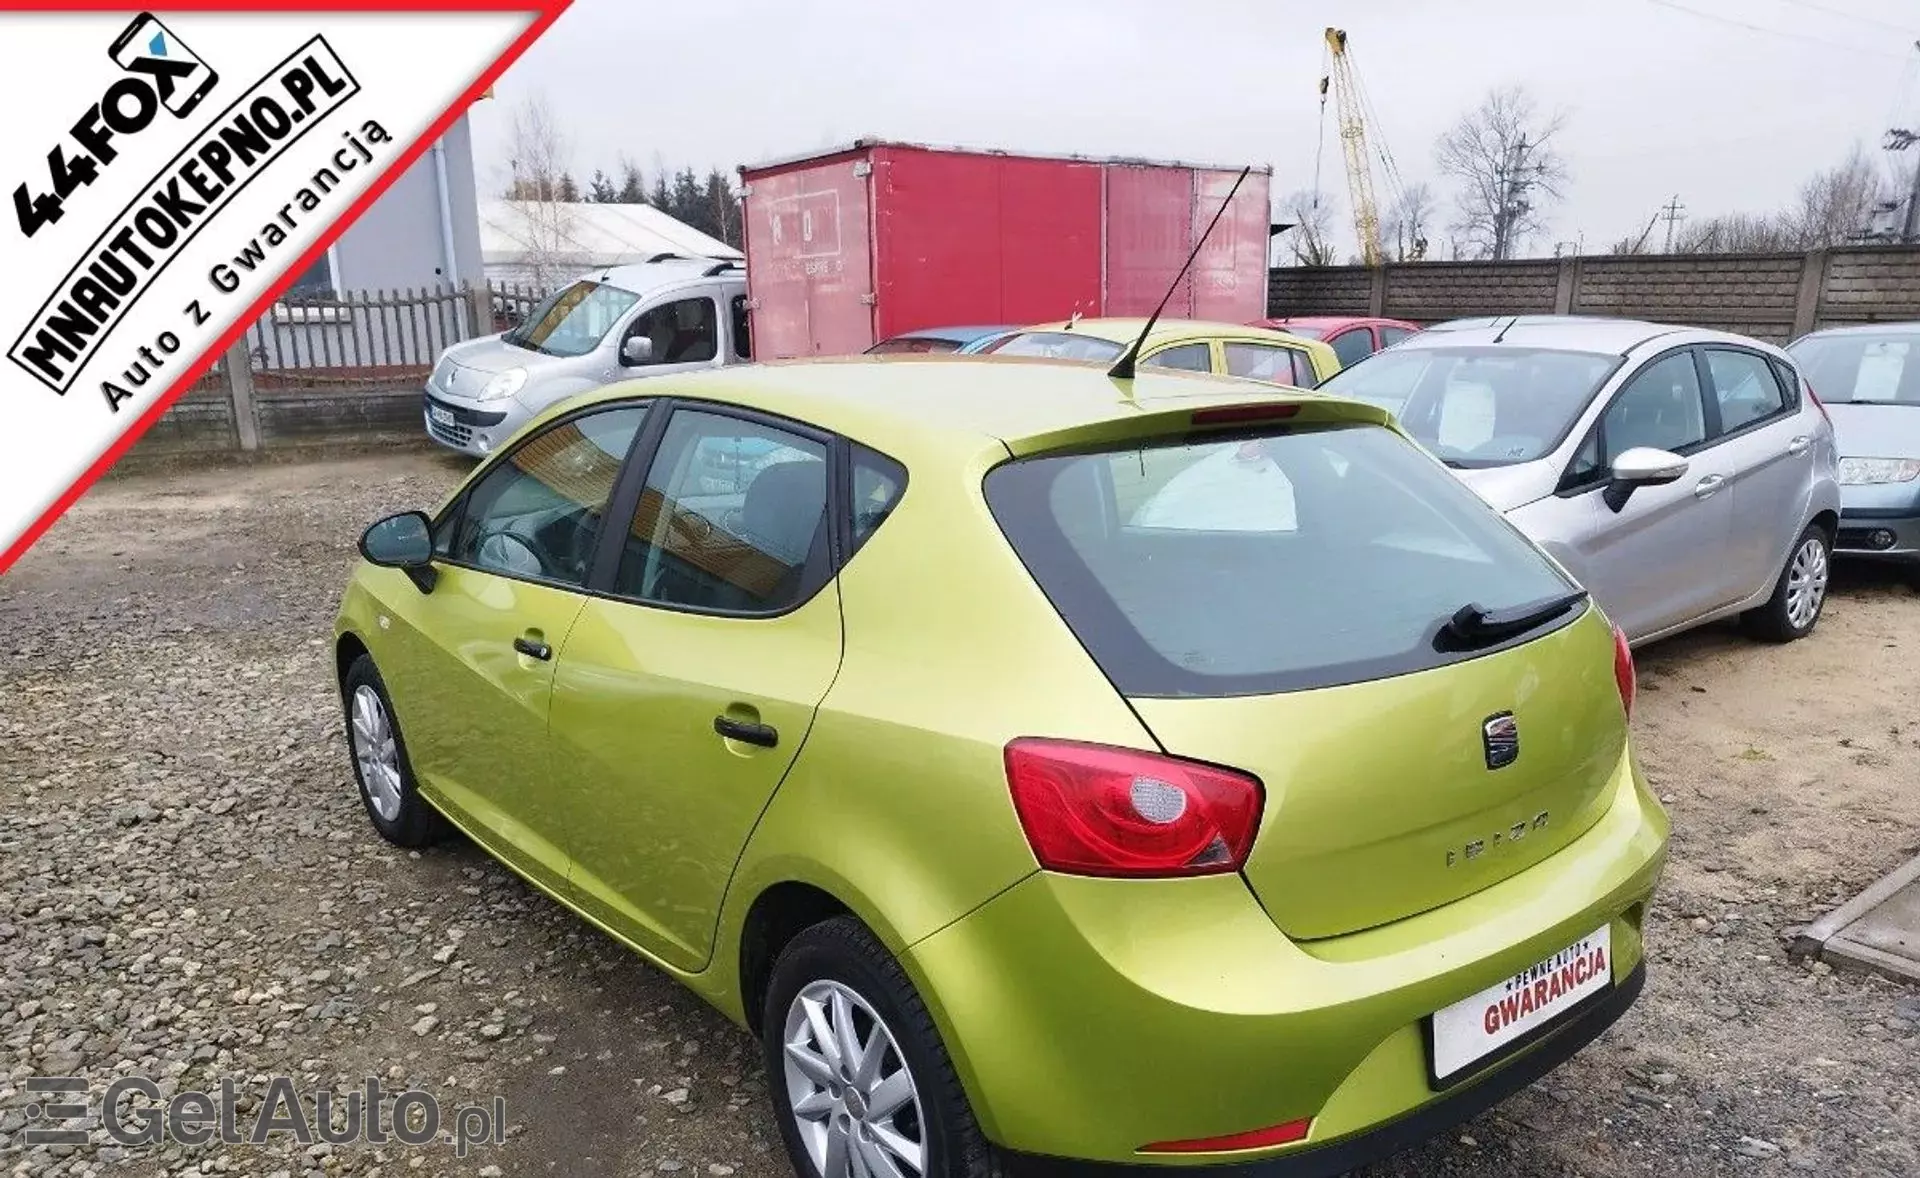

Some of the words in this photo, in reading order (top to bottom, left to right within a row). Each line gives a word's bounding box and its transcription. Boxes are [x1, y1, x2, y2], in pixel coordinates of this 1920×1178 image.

[1446, 810, 1549, 868] IBIZA
[1484, 946, 1606, 1035] GWARANCJA
[1515, 957, 1553, 990] PEWNE
[1556, 942, 1581, 968] AUTO
